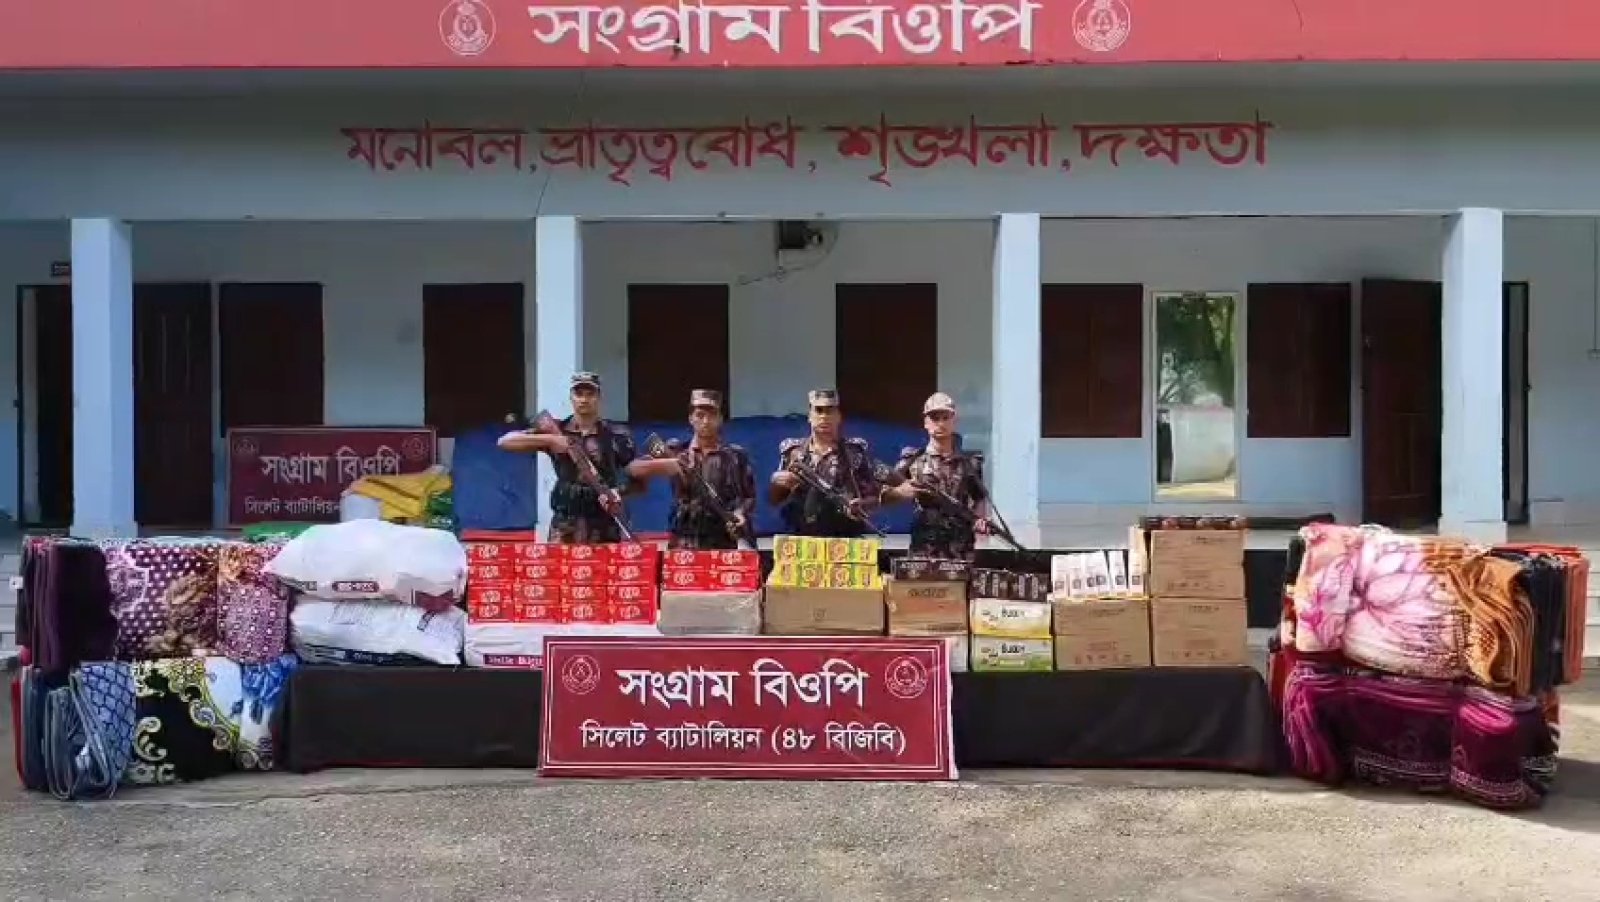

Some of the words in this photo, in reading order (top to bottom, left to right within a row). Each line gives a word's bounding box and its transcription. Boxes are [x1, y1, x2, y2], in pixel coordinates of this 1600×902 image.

[528, 0, 792, 54] সংগ্রাম
[1072, 108, 1275, 167] দক্ষতা
[259, 453, 330, 485] সংগ্রাম
[244, 496, 280, 514] সিলেট
[615, 664, 740, 709] সংগ্রাম
[749, 658, 869, 708] বিওপি
[579, 718, 649, 750] সিলেট
[655, 720, 764, 750] ব্যাটালিয়ন
[772, 724, 815, 755] (৪৮
[824, 721, 906, 757] বিজিবি)
